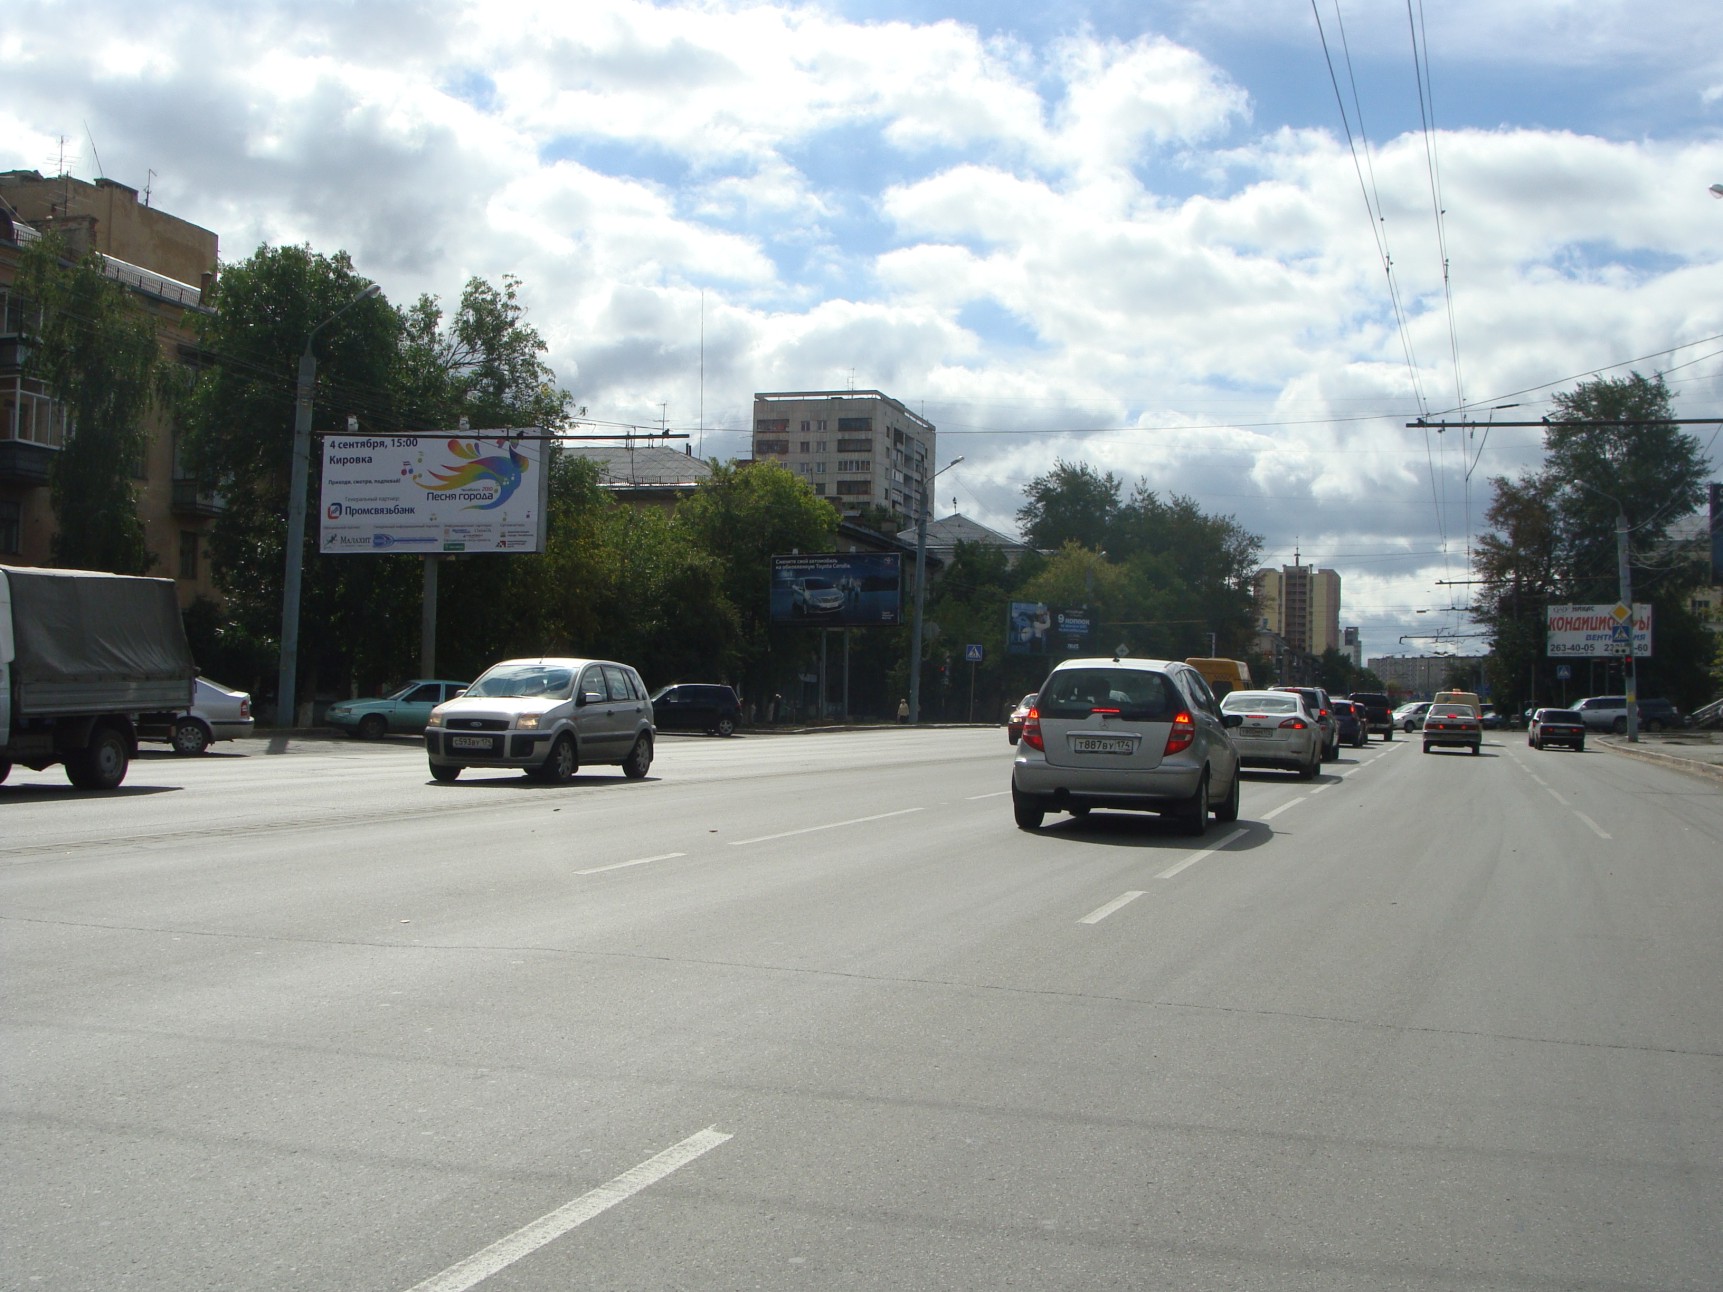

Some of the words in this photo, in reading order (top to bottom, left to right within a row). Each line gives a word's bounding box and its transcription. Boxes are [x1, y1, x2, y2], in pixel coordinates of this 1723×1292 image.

[330, 440, 336, 449] 4
[338, 439, 388, 450] сентября,
[391, 438, 418, 447] 15:00
[329, 455, 373, 466] Кировка
[426, 492, 457, 501] Песня
[458, 492, 494, 502] города
[345, 505, 416, 517] Промсвязьбанк
[1057, 614, 1065, 624] 9
[1550, 644, 1595, 652] 263-40-05
[1078, 740, 1114, 750] Т887ВУ
[1117, 740, 1130, 748] 174
